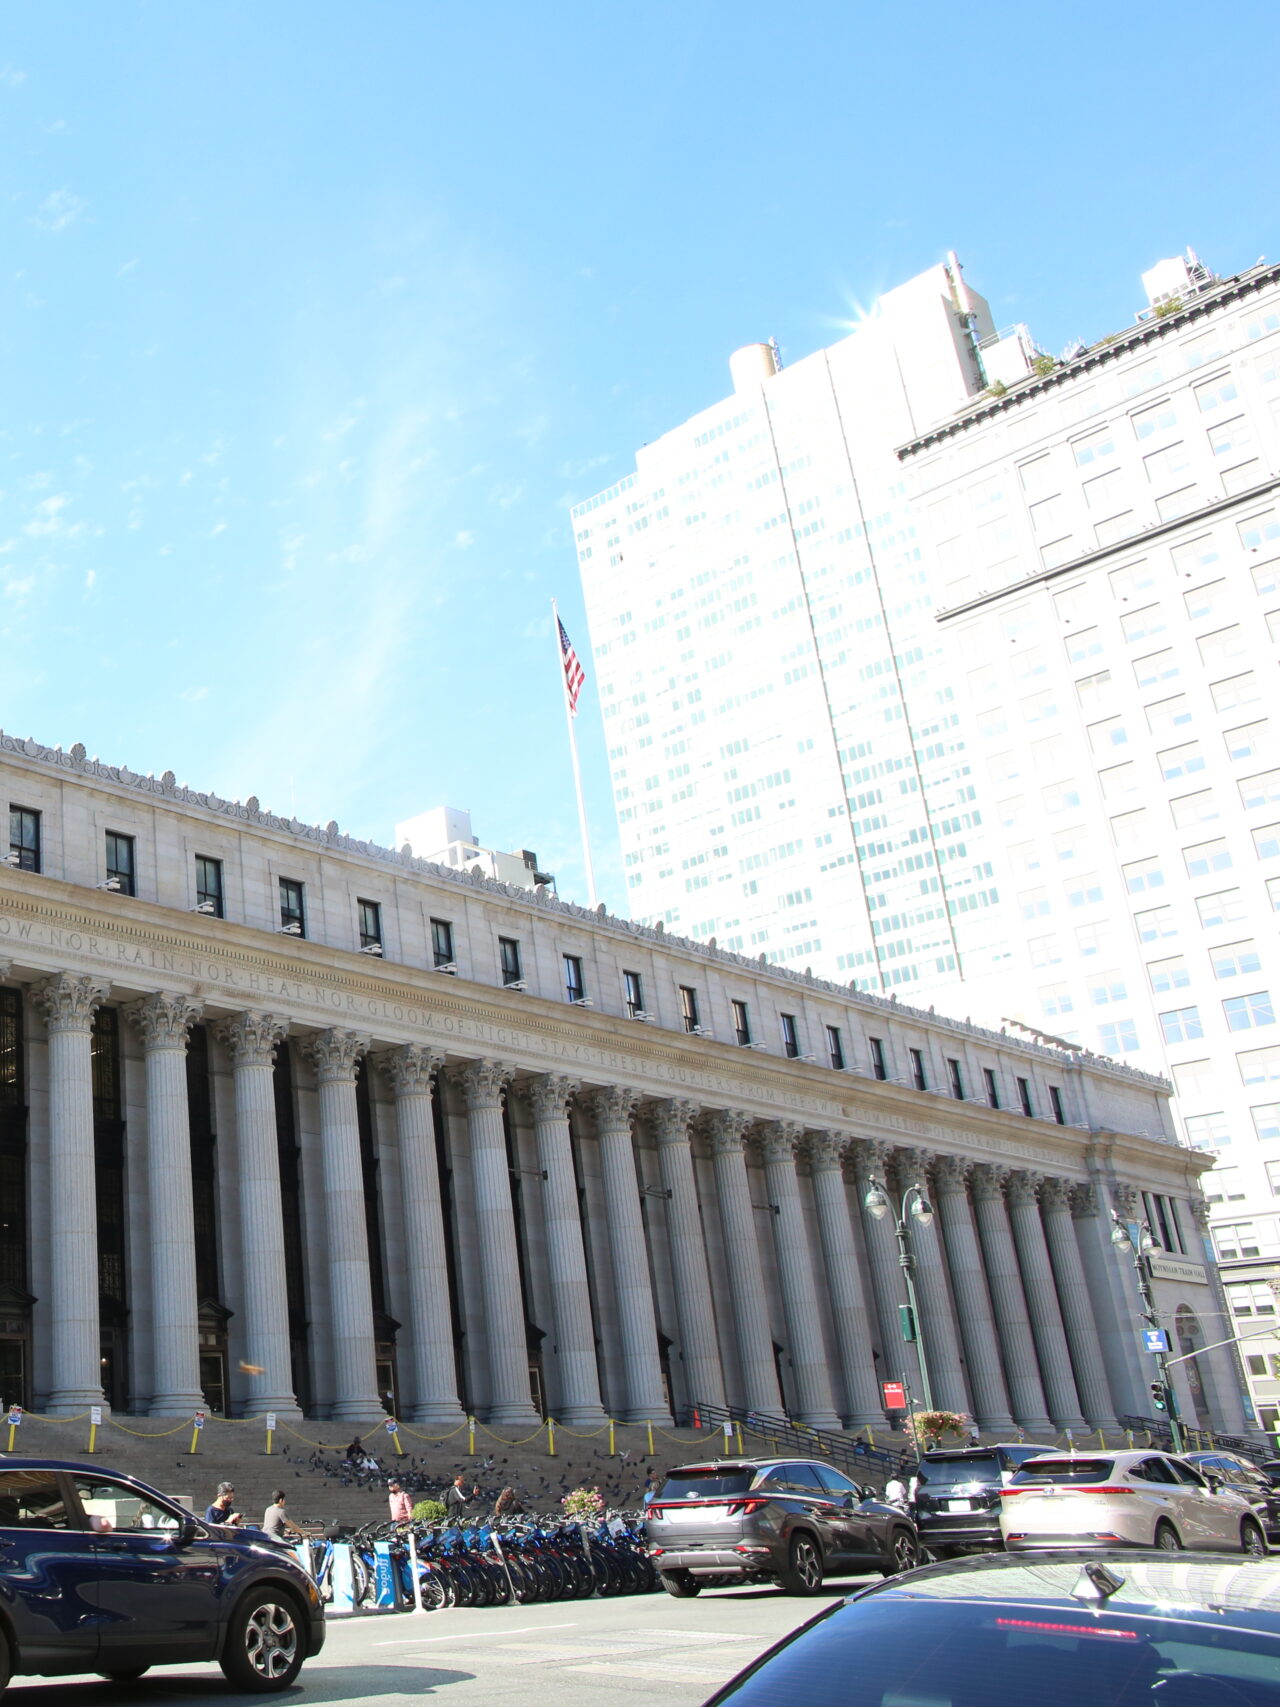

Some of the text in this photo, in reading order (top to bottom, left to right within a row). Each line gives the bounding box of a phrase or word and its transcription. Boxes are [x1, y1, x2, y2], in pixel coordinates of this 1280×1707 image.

[50, 930, 102, 956] NOR
[117, 943, 175, 971] RAIN
[190, 959, 239, 985] NOR
[249, 974, 304, 999] HEAT
[315, 989, 361, 1012] NOR
[367, 1000, 433, 1028] GLOOM
[444, 1016, 464, 1034] OF
[475, 1024, 531, 1049] NIGHT
[541, 1037, 591, 1061] STAYS
[599, 1052, 652, 1073] THESE
